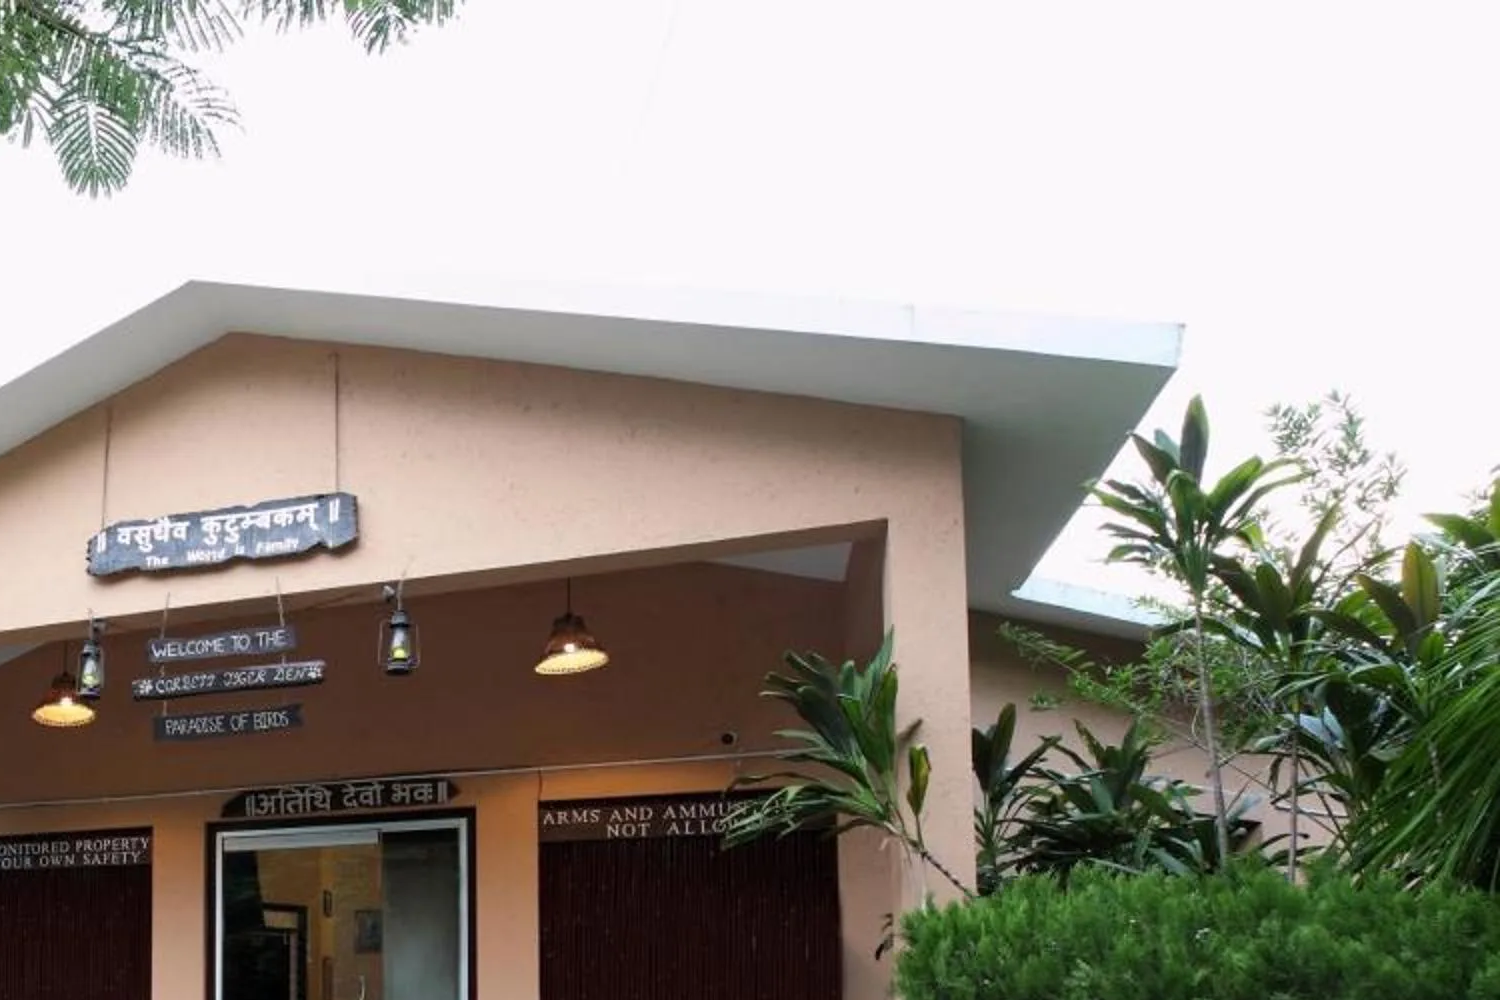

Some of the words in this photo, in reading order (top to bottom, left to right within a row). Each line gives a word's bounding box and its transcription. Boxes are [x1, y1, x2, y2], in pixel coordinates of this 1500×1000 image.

[117, 516, 190, 552] वसुधैव
[200, 502, 319, 545] कुटुम्बकम्
[145, 555, 170, 567] The
[152, 637, 225, 658] WELCOME
[230, 635, 251, 650] TO
[256, 629, 287, 647] THE
[165, 716, 225, 736] PARADISE
[230, 715, 249, 732] OF
[253, 711, 290, 730] BIRDS
[543, 809, 601, 825] ARMS
[609, 807, 653, 822] AND
[606, 823, 651, 838] NOT
[75, 837, 150, 852] PROPERTY
[39, 854, 76, 868] OWN
[82, 851, 141, 866] SAFETY
